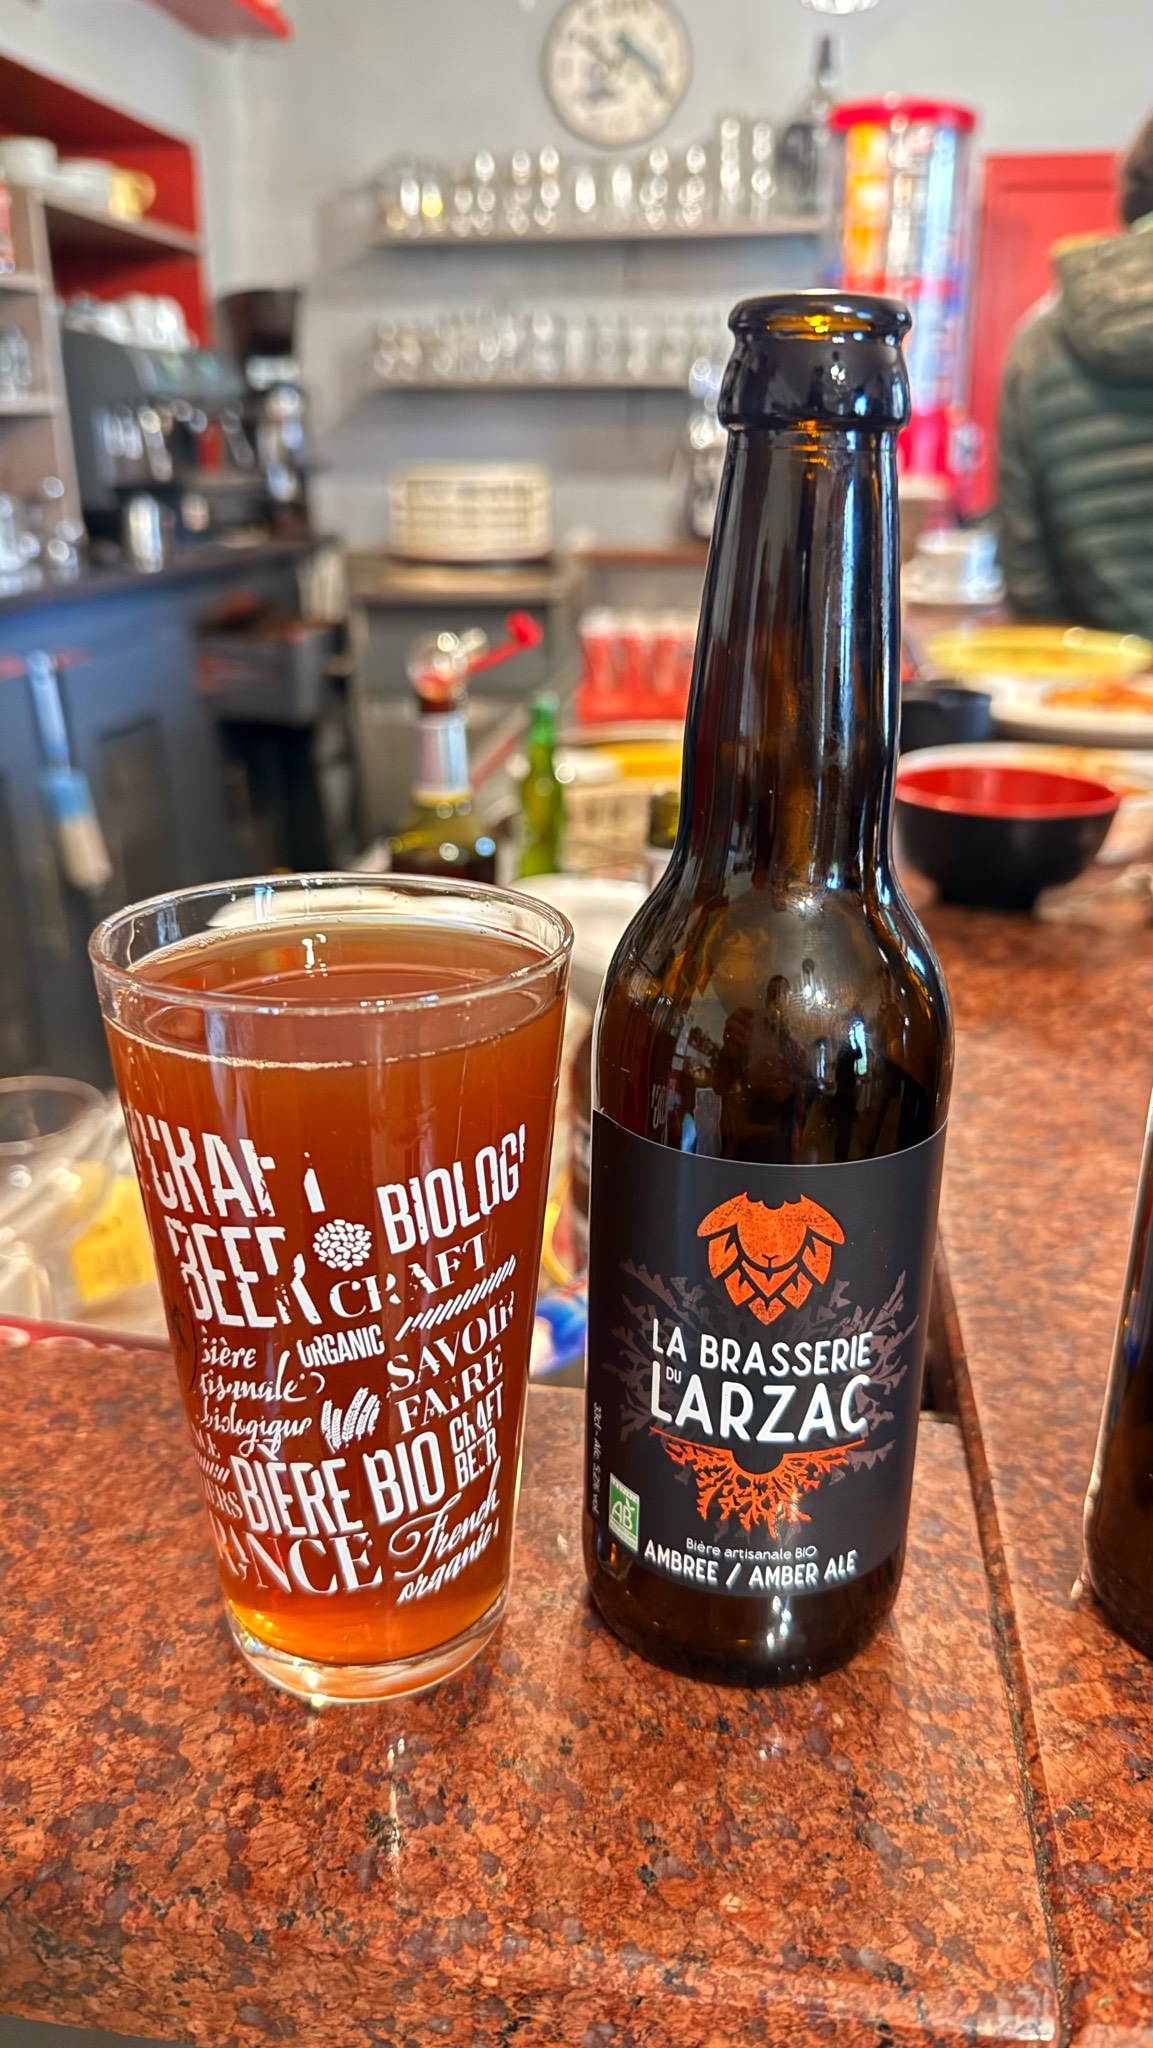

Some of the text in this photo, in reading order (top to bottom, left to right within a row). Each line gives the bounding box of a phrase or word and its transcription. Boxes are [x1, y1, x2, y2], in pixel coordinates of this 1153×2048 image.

[297, 1324, 386, 1370] ORGANIC
[651, 1317, 874, 1378] LA BRASSERIE
[665, 1364, 683, 1385] DU
[650, 1360, 872, 1444] LARZAC
[230, 1430, 446, 1536] BIÈRE BIO
[388, 1456, 501, 1578] French
[611, 1500, 633, 1531] AB
[209, 1509, 384, 1594] RANCE
[643, 1539, 859, 1588] AMBREE / AMBER ALE
[686, 1537, 818, 1561] Bière artisanale BIO
